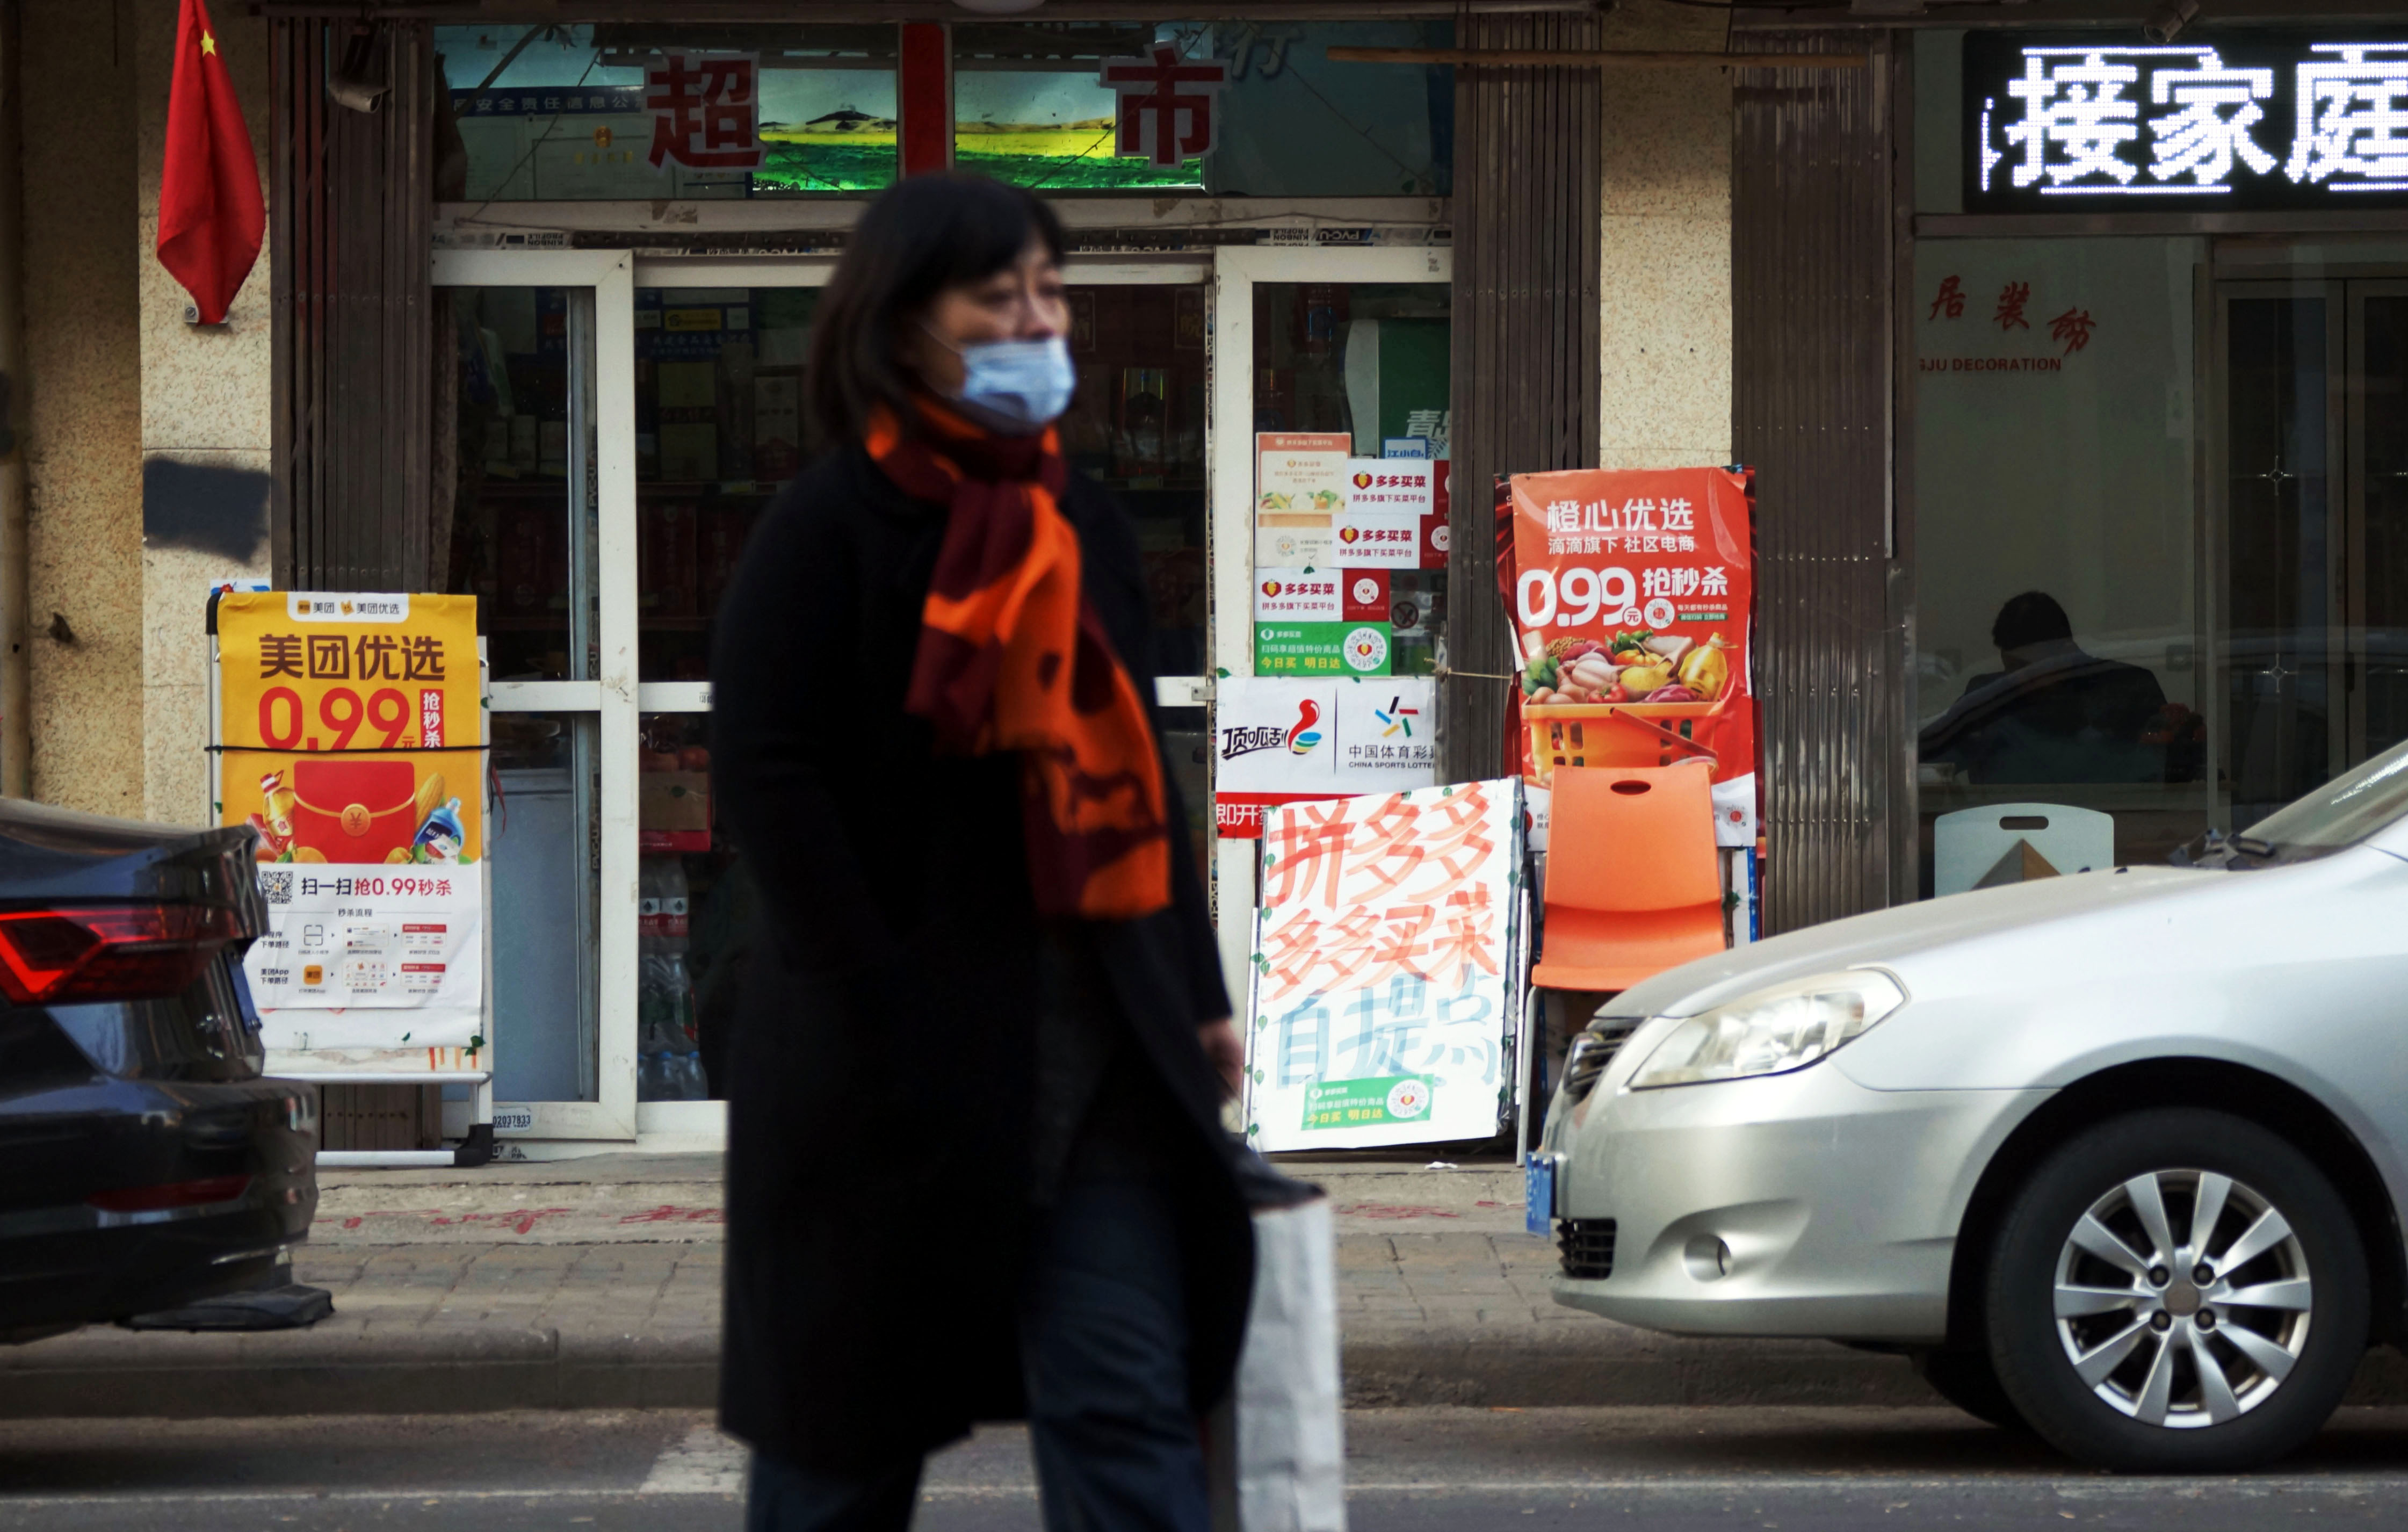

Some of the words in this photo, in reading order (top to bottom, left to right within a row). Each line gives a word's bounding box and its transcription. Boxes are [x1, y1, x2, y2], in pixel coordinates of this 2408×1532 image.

[647, 55, 765, 168] 超
[1108, 48, 1223, 164] 市
[1981, 48, 2408, 188] 接家庭
[1953, 358, 2062, 371] DECORATION
[1376, 475, 1426, 488] 多多买菜
[1352, 494, 1426, 504] 拼多多旗下买菜平台
[1546, 497, 1695, 533] 橙心优选
[1362, 529, 1413, 543] 多多买菜
[1548, 536, 1619, 555] 滴滴旗下
[1624, 534, 1695, 554] 社区电商
[1339, 548, 1412, 558] 拼多多旗下买菜平台
[1284, 582, 1335, 596] 多多买菜
[1516, 567, 1636, 627] 0.99
[1643, 566, 1728, 598] 抢秒杀
[314, 602, 335, 613] 美团
[357, 603, 400, 615] 美团优选
[1262, 602, 1335, 611] 拼多多旗下买菜平台
[259, 633, 445, 681] 美团优选
[1261, 657, 1297, 669] 今日买
[1304, 657, 1341, 669] 明日达
[258, 686, 410, 751] 0.99
[423, 691, 442, 748] 抢秒杀
[1265, 782, 1495, 910] 拼多多
[337, 908, 373, 917] 秒杀流程
[261, 941, 290, 949] 下单路径
[1262, 881, 1501, 1002] 多多买菜
[261, 977, 288, 985] 下单路径
[1272, 963, 1499, 1090] 自提点
[1307, 1111, 1342, 1124] 今日买
[1348, 1108, 1383, 1120] 明日达
